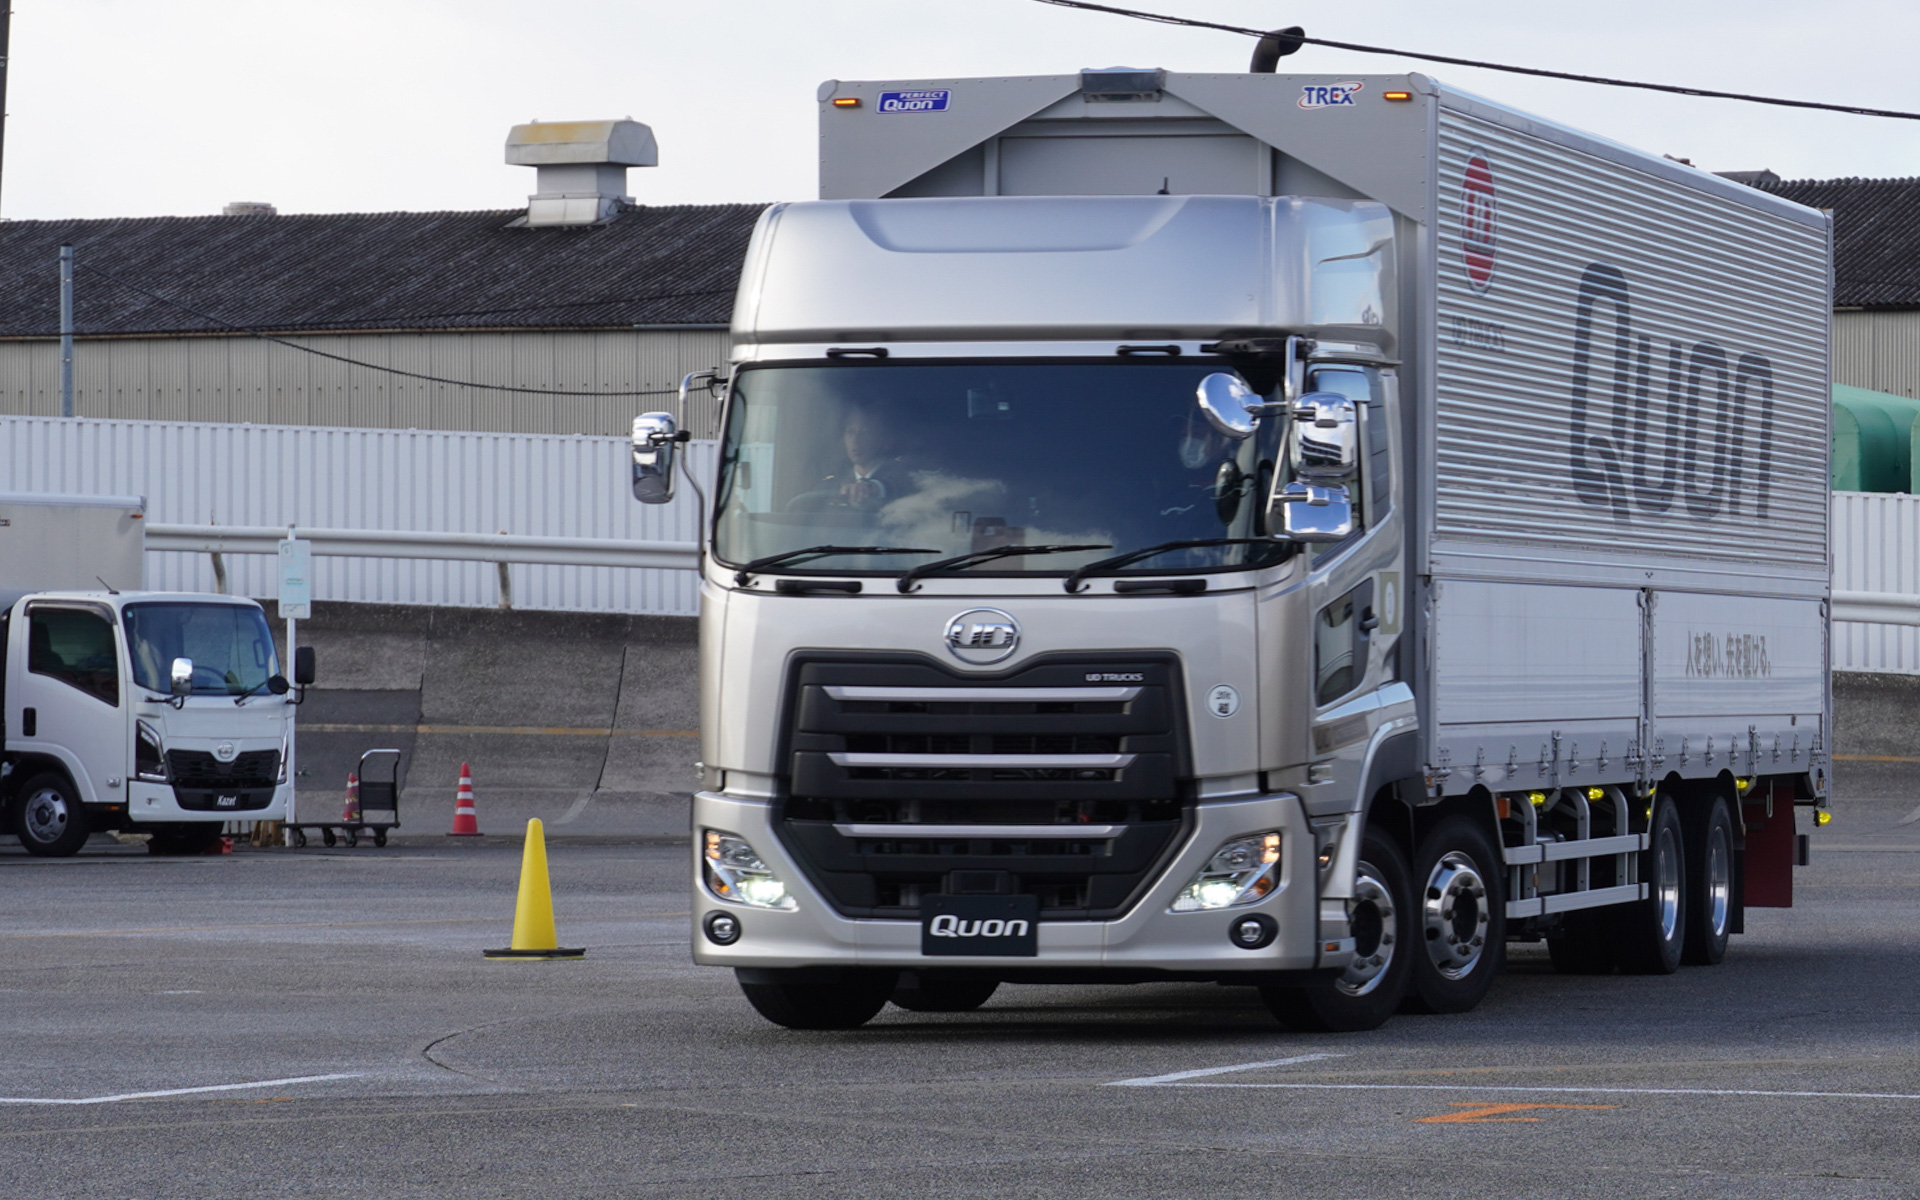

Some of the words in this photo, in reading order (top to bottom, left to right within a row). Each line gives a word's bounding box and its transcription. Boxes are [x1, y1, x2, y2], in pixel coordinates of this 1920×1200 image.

[884, 99, 933, 111] Quon
[1303, 86, 1354, 105] TREX
[1570, 262, 1773, 524] Quon
[1085, 673, 1101, 681] UD
[1102, 673, 1144, 681] TRUCKS
[930, 914, 1029, 938] Quon
